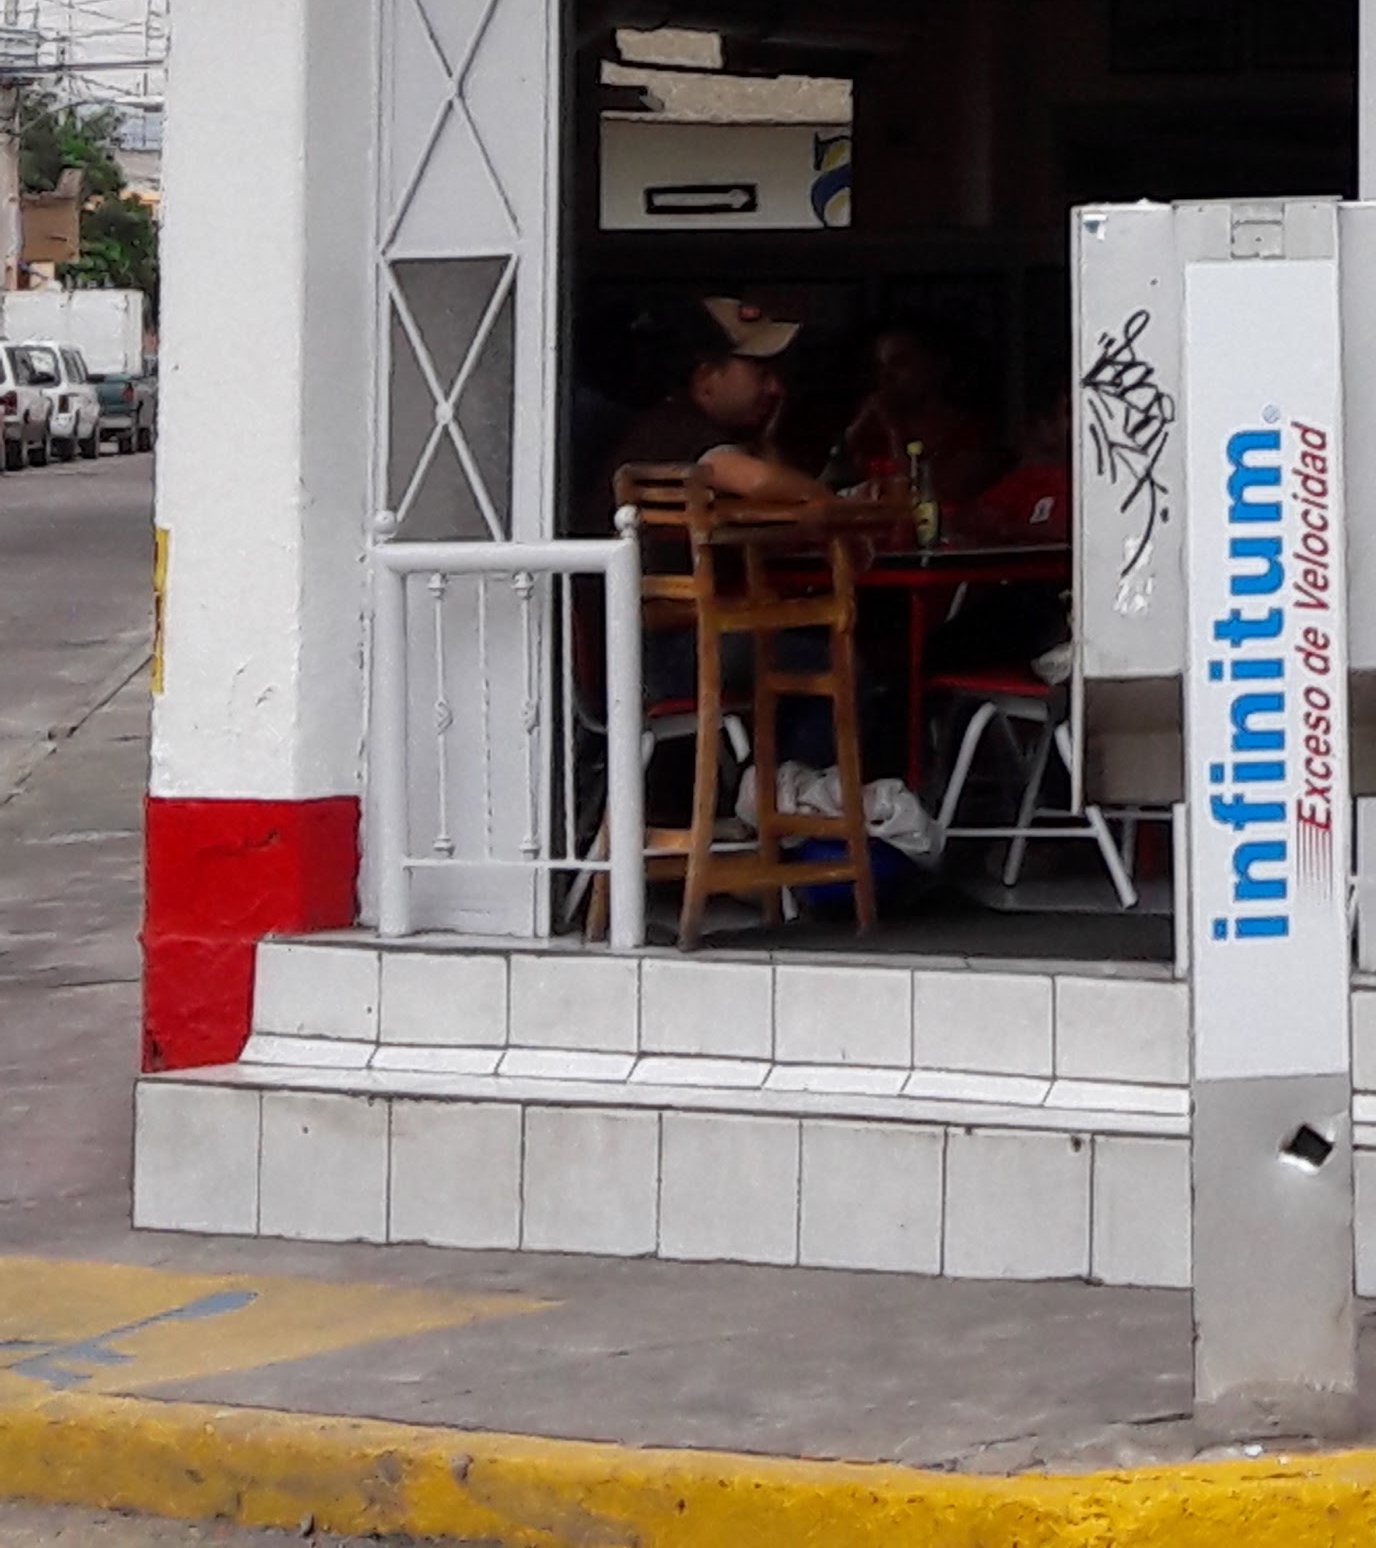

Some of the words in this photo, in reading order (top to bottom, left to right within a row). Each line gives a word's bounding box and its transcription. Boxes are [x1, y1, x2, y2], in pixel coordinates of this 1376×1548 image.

[1293, 422, 1330, 614] Velocidad
[1208, 427, 1290, 942] infinitum
[1294, 628, 1331, 674] de
[1295, 685, 1334, 833] Exceso
